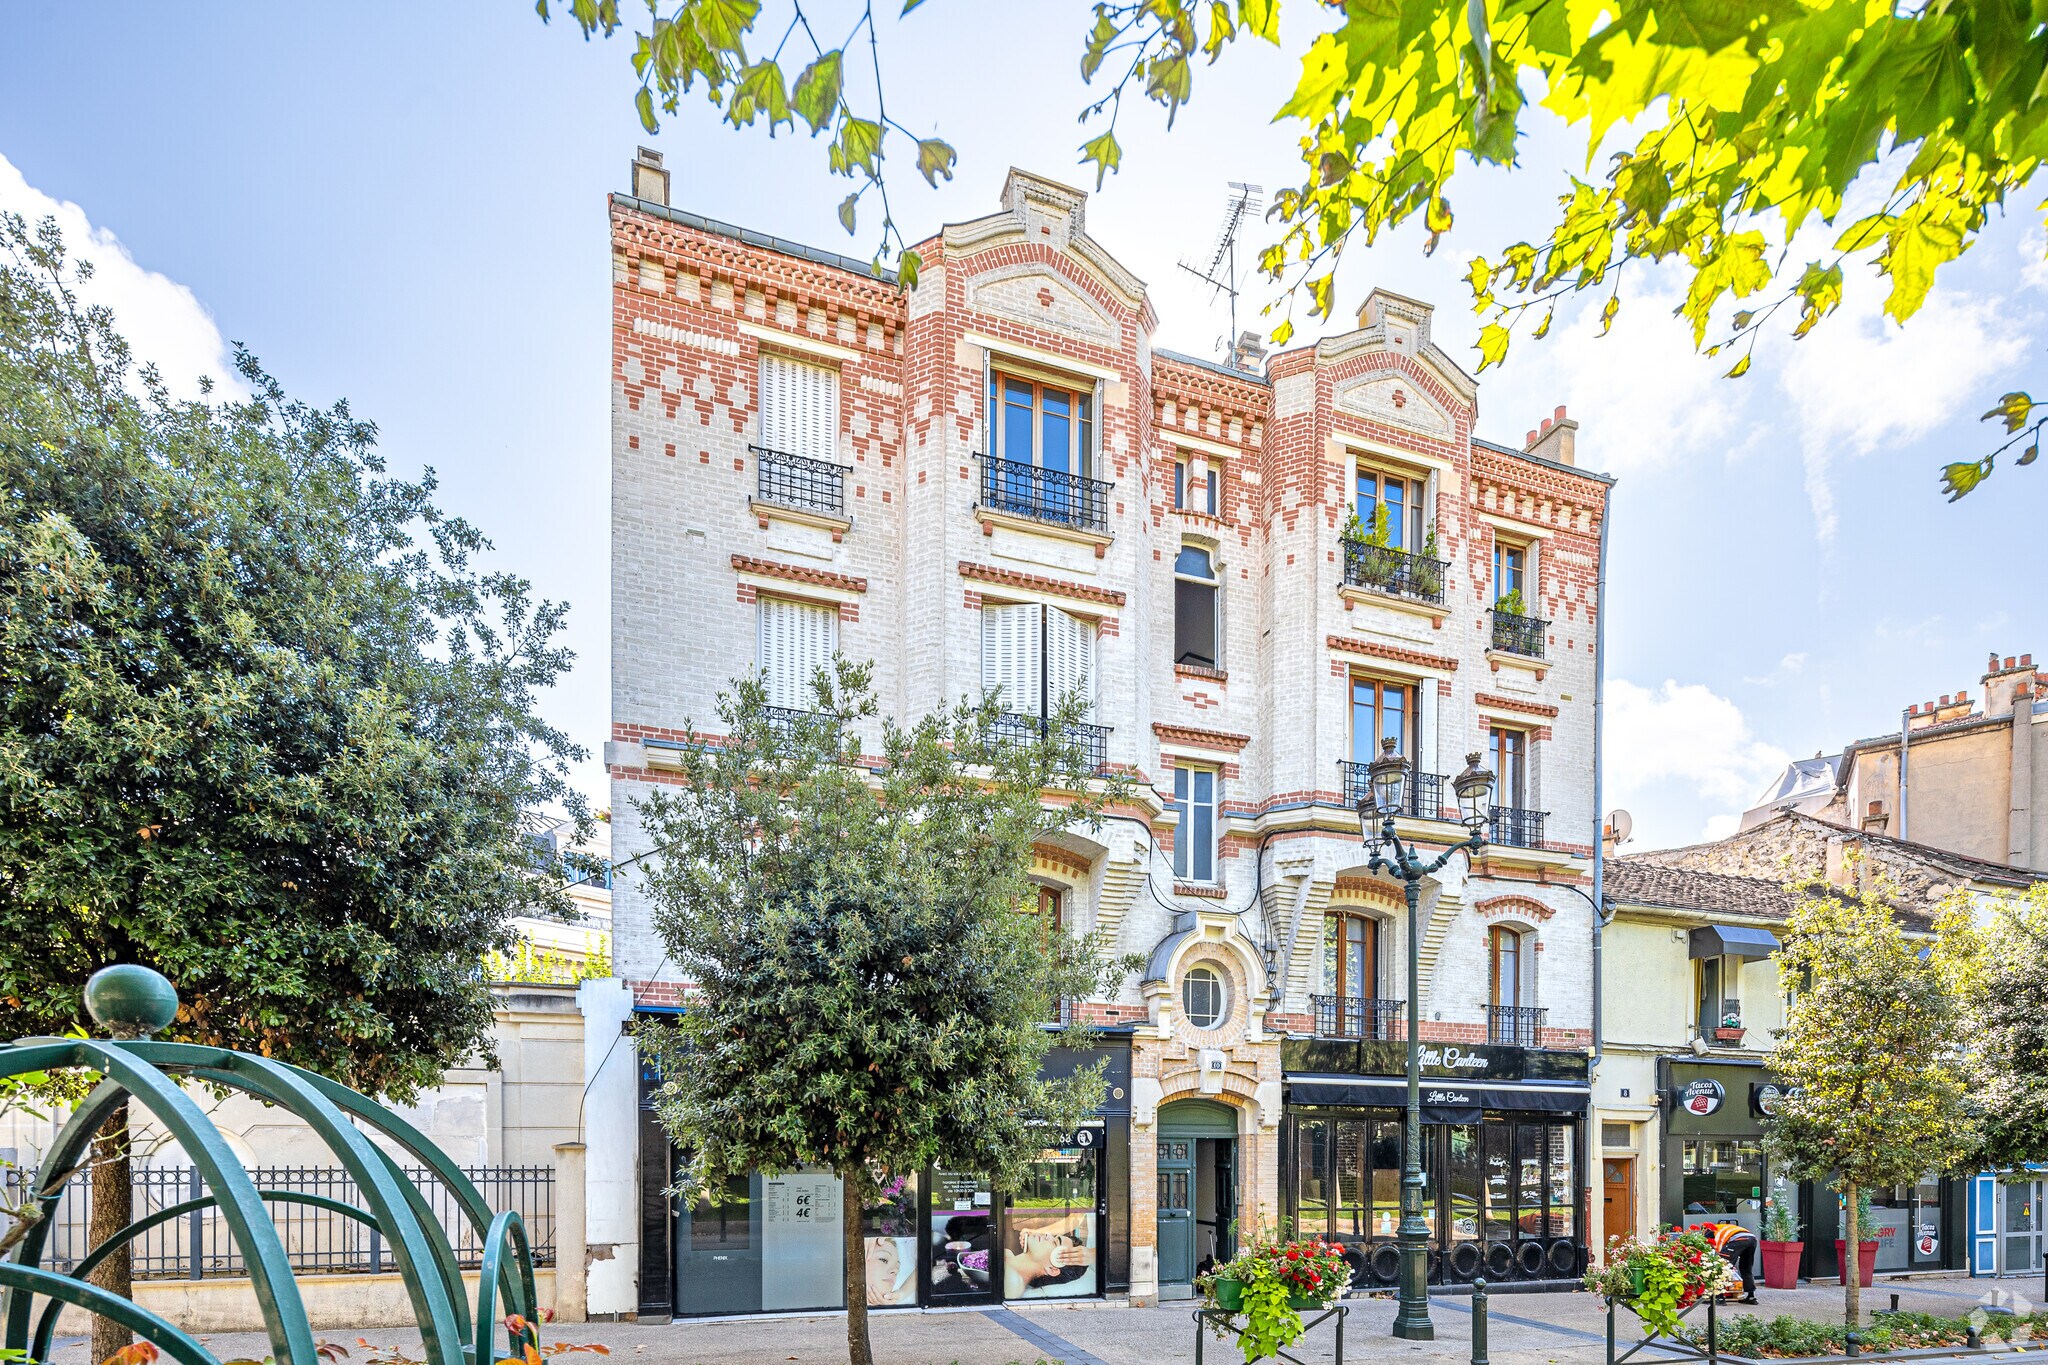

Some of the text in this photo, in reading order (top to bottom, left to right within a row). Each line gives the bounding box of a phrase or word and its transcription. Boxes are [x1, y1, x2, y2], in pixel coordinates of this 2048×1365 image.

[1405, 1045, 1488, 1071] Little Canteen
[1690, 1081, 1712, 1089] Tacos
[1427, 1090, 1470, 1104] Little Canteen
[1685, 1088, 1714, 1097] Avenue
[796, 1195, 811, 1205] 6€
[796, 1208, 811, 1218] 4€
[1921, 1223, 1935, 1231] Tacos
